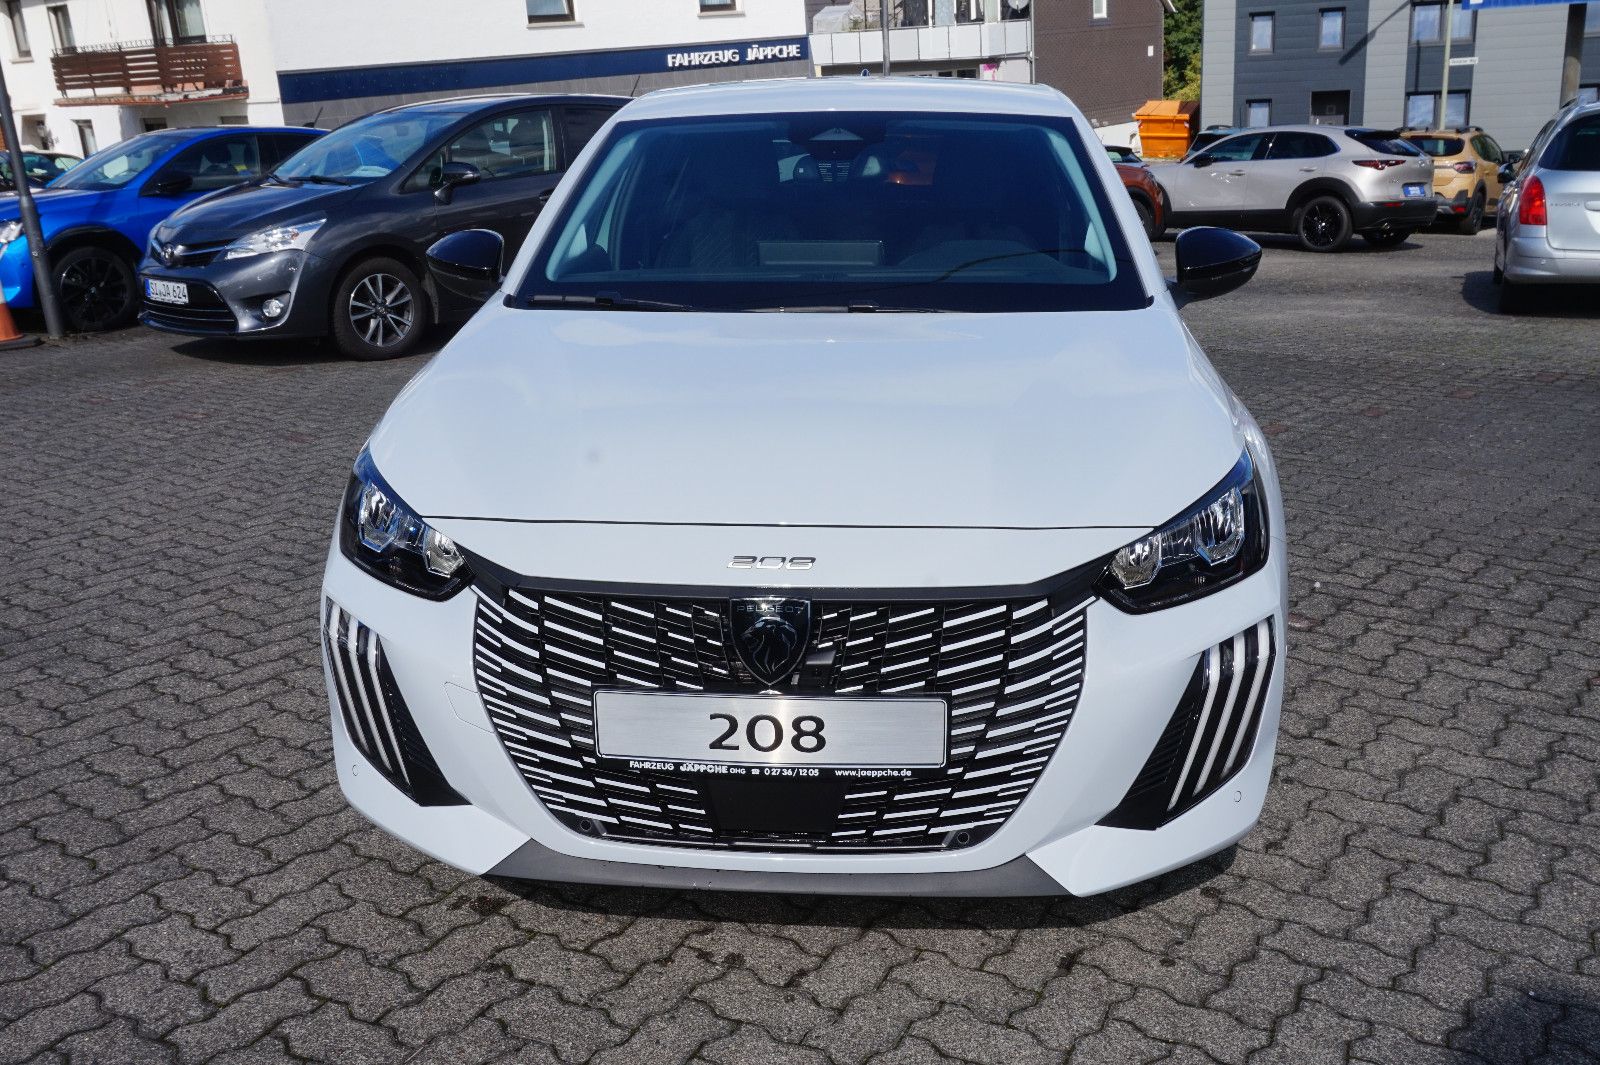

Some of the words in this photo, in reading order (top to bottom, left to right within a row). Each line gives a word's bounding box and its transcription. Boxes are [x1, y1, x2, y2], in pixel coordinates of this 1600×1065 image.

[667, 49, 739, 67] FAHRZEUG
[746, 44, 801, 61] JÄPPCHE
[173, 285, 187, 299] 624
[727, 555, 816, 570] 208
[737, 604, 803, 613] PEUGEOT
[709, 713, 827, 753] 208
[629, 760, 675, 770] FAHRZEUG
[679, 762, 728, 774] JÄPPCHE
[729, 767, 746, 775] OHG
[835, 768, 912, 778] www.jaeppche.de
